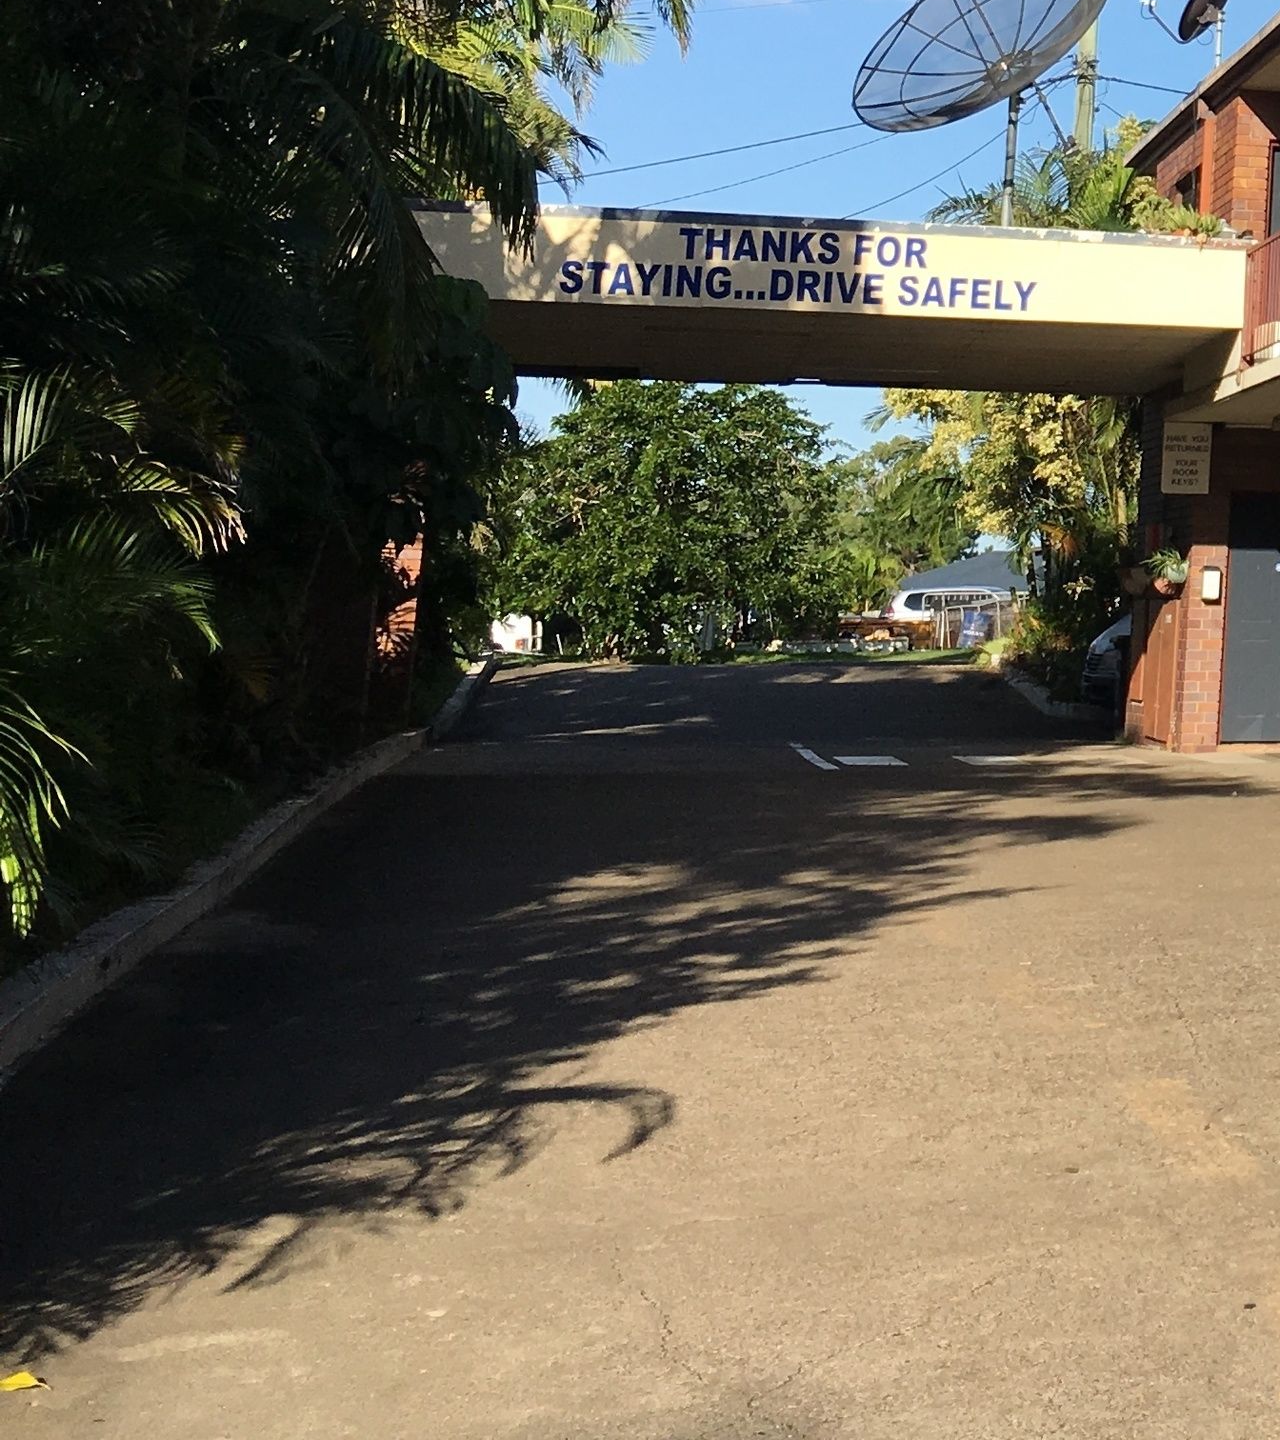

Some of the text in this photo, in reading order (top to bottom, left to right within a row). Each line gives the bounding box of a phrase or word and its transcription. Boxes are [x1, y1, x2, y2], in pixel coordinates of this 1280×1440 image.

[679, 227, 929, 269] THANKS FOR
[897, 275, 1038, 312] SAFELY
[1191, 434, 1209, 443] YOU
[1172, 468, 1199, 476] ROOM
